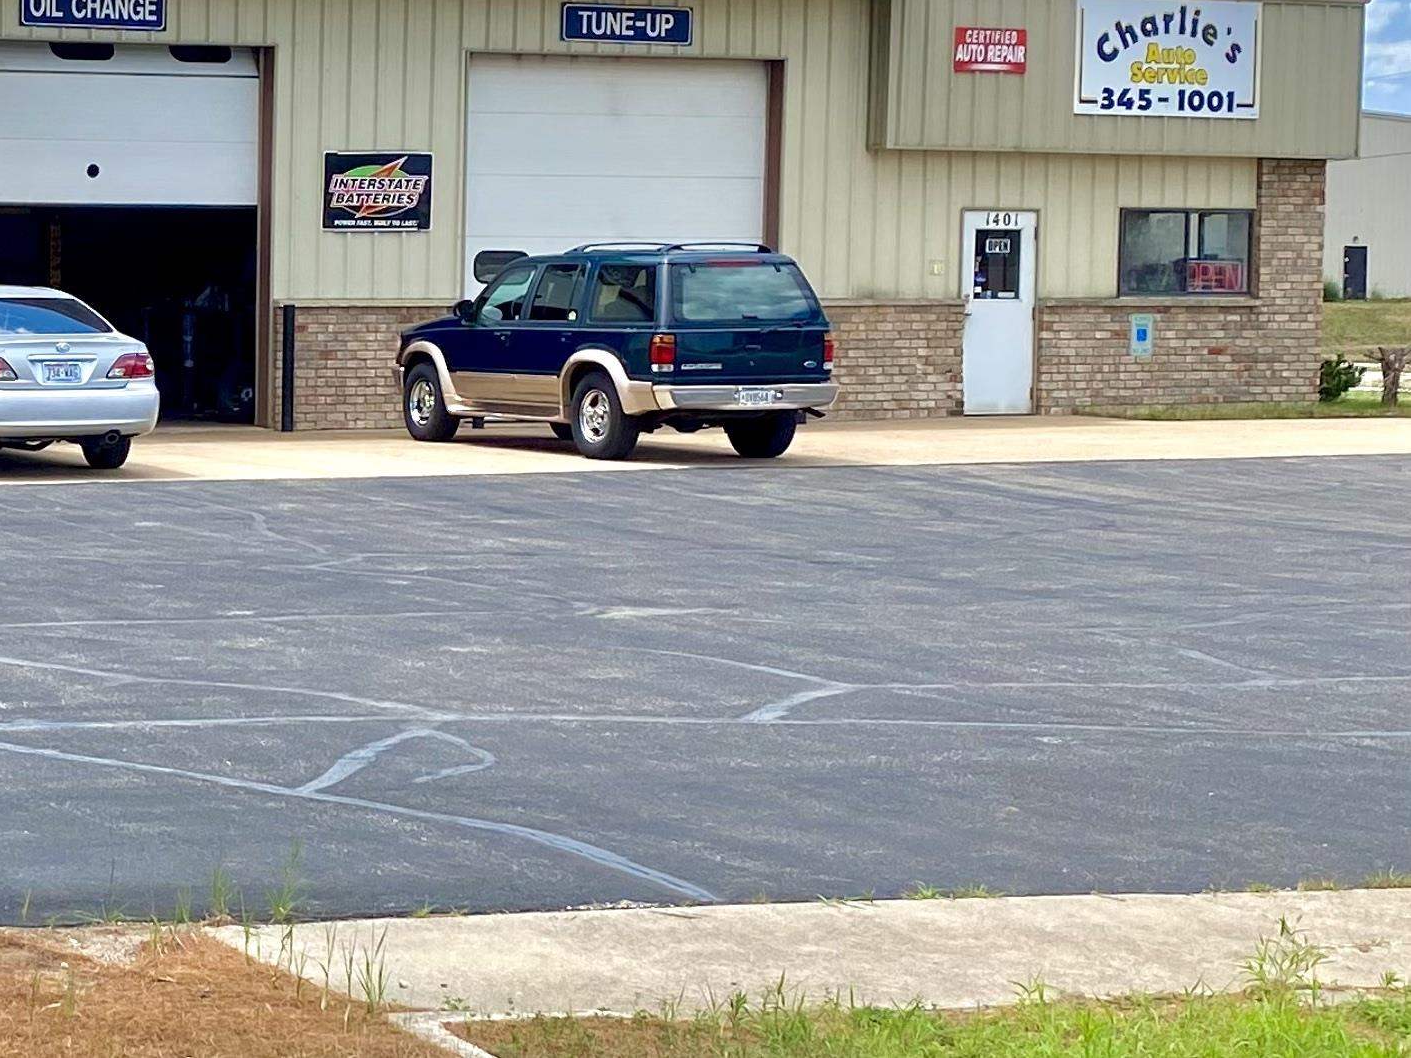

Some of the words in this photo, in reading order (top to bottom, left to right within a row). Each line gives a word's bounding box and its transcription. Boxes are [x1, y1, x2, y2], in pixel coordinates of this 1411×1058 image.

[578, 11, 674, 37] TUNE-UP
[965, 29, 1018, 44] CERTIFIED
[1097, 5, 1242, 64] Charlie's
[955, 44, 985, 62] AUTO
[987, 45, 1026, 63] REPAIR
[1145, 42, 1197, 66] Auto
[1130, 61, 1208, 86] Service
[332, 178, 422, 191] INTERSTATE
[335, 192, 416, 205] BATTERIES
[986, 212, 1019, 227] 1401
